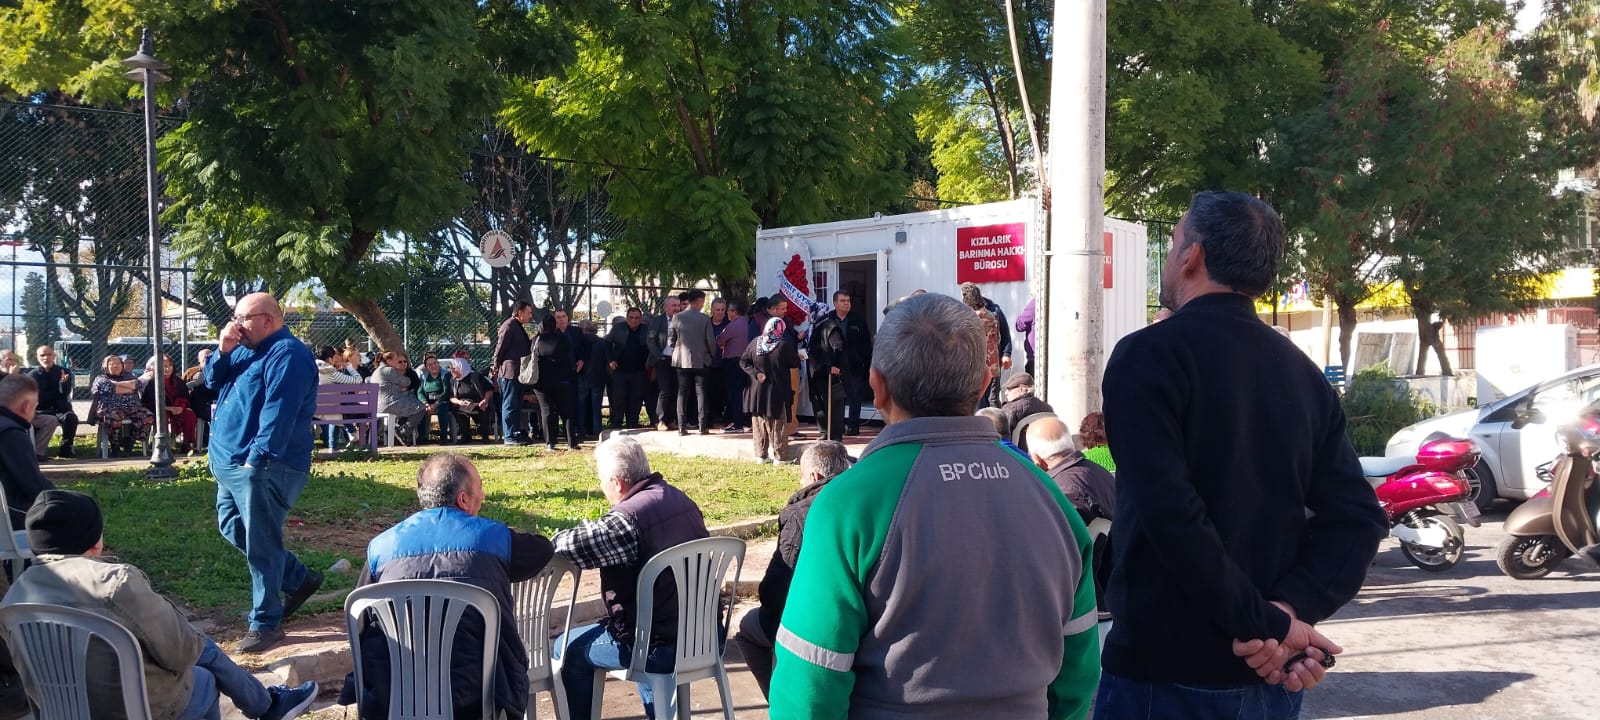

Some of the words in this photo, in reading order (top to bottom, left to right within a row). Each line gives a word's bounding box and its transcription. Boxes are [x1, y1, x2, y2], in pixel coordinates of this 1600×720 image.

[970, 234, 1012, 247] KIZILARIK
[959, 248, 997, 260] BARINMA
[973, 258, 1008, 271] BÜROSU
